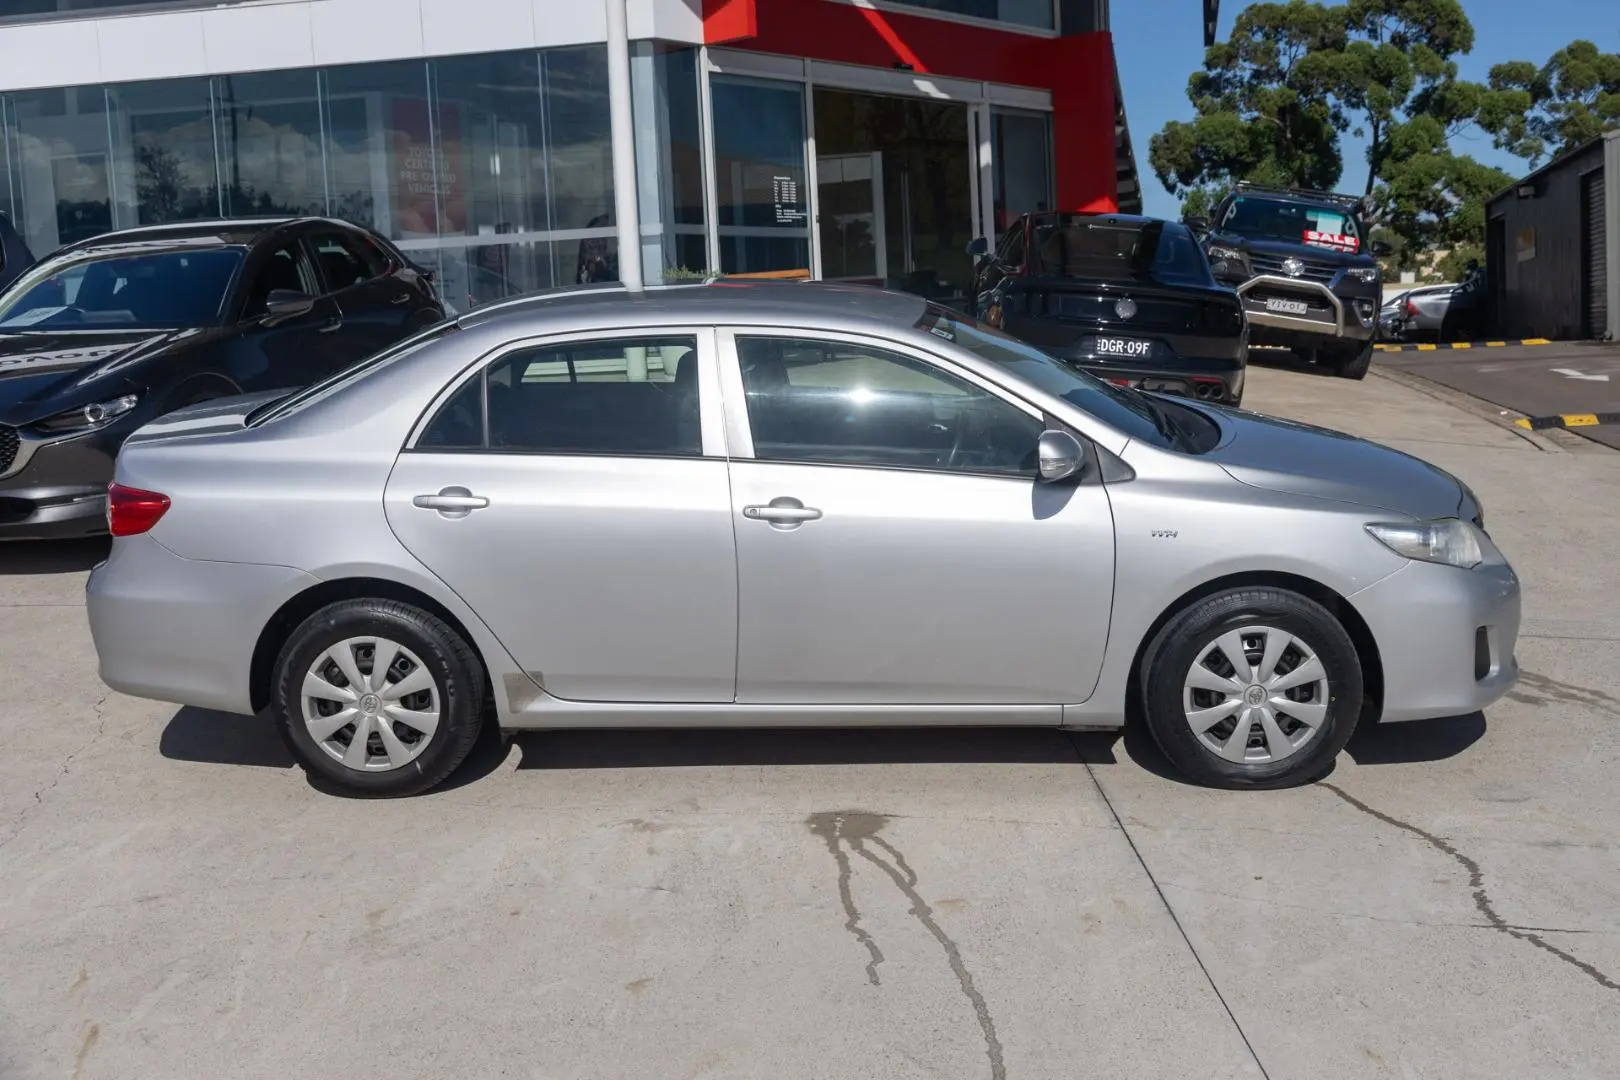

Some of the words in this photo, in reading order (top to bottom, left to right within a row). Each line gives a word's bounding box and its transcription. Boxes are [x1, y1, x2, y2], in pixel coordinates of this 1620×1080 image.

[408, 146, 444, 158] TOYOA
[405, 159, 450, 171] CERTID
[420, 172, 456, 183] OWED
[1307, 231, 1356, 246] SALE
